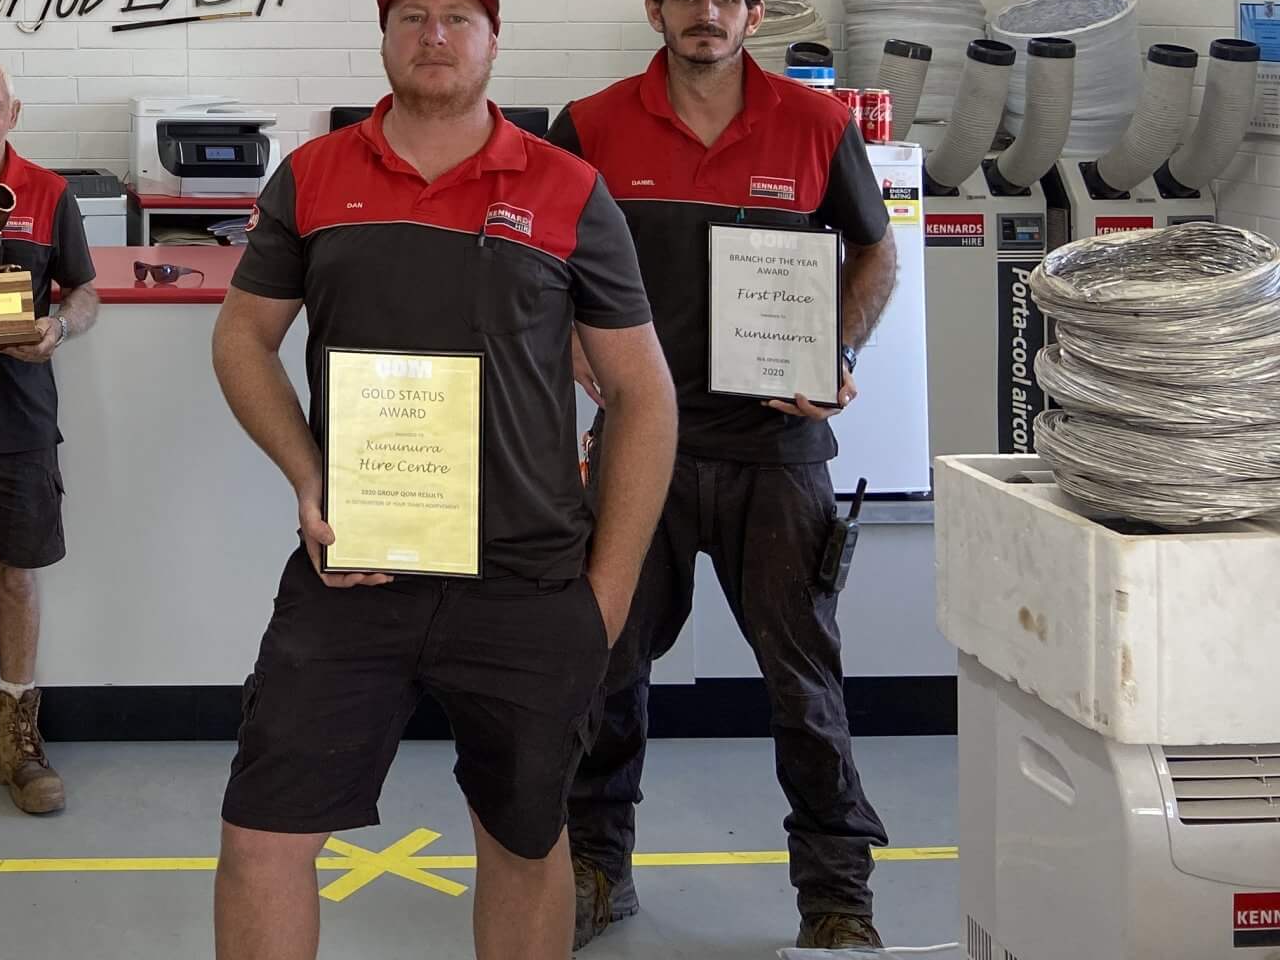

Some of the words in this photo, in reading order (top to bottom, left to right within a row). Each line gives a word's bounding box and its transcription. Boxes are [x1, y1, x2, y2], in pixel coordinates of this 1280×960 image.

[752, 183, 793, 192] KENNARDS
[926, 224, 983, 234] KENNARDS
[962, 237, 982, 246] HIRE
[729, 254, 763, 263] BRANCH
[779, 258, 794, 266] THE
[797, 259, 818, 267] YEAR
[757, 267, 789, 276] AWARD
[737, 288, 771, 301] First
[773, 291, 815, 304] Place
[1012, 266, 1032, 386] Porta-cool
[734, 327, 817, 344] Kununurra
[762, 368, 784, 377] 2020
[361, 388, 396, 401] GOLD
[399, 390, 445, 402] STATUS
[379, 407, 427, 419] AWARD
[365, 440, 444, 454] Kununurra
[359, 458, 395, 472] Hire
[397, 460, 451, 474] Centre
[1237, 909, 1280, 925] KENN
